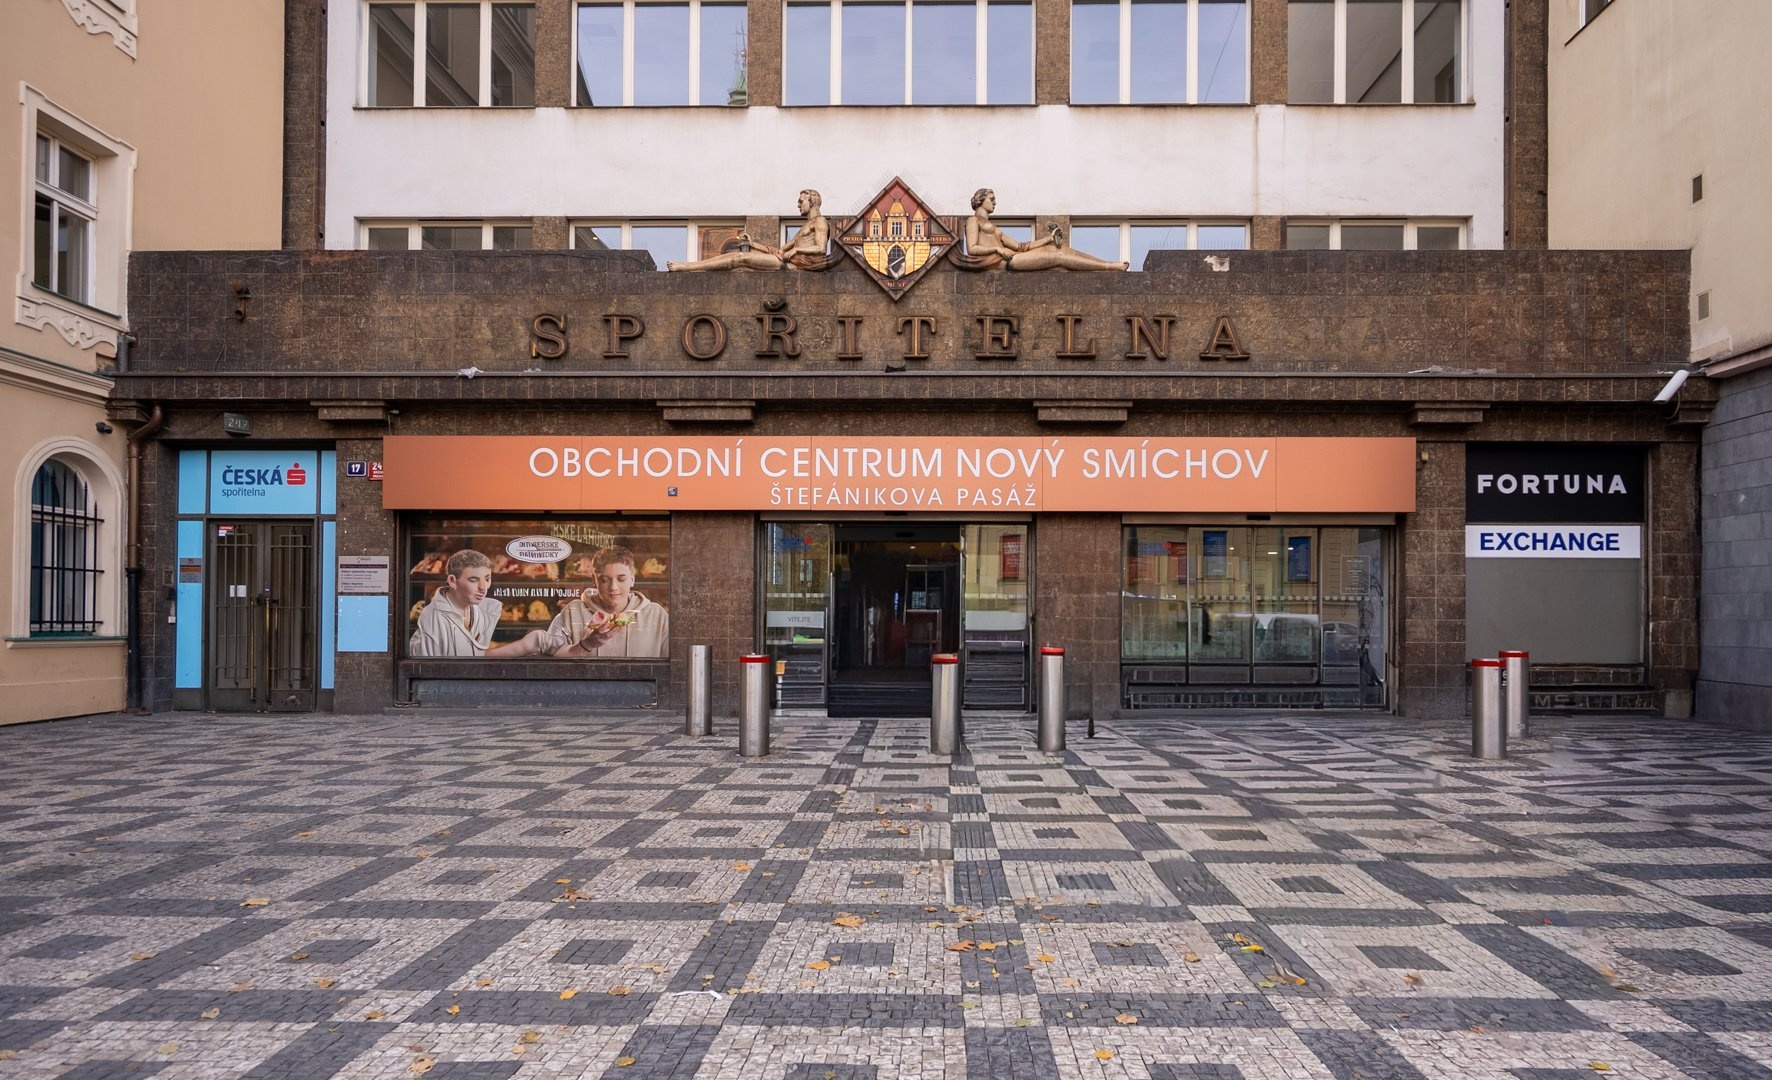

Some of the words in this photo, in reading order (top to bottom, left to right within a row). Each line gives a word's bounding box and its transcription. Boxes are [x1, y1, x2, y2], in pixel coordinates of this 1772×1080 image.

[530, 300, 1250, 360] SPOŘITELNA
[351, 463, 361, 473] 17
[372, 462, 383, 471] 24
[529, 439, 743, 477] OBCHODNÍ
[760, 447, 943, 477] CENTRUM
[957, 440, 1065, 478] NOVÝ
[1082, 440, 1269, 479] SMÍCHOV
[222, 465, 283, 485] ČESKÁ
[1477, 474, 1628, 494] FORTUNA
[221, 488, 266, 498] spořitelna
[770, 482, 943, 506] ŠTEFÁNIKOVA
[957, 484, 1037, 506] PASÁŽ
[1480, 533, 1620, 551] EXCHANGE
